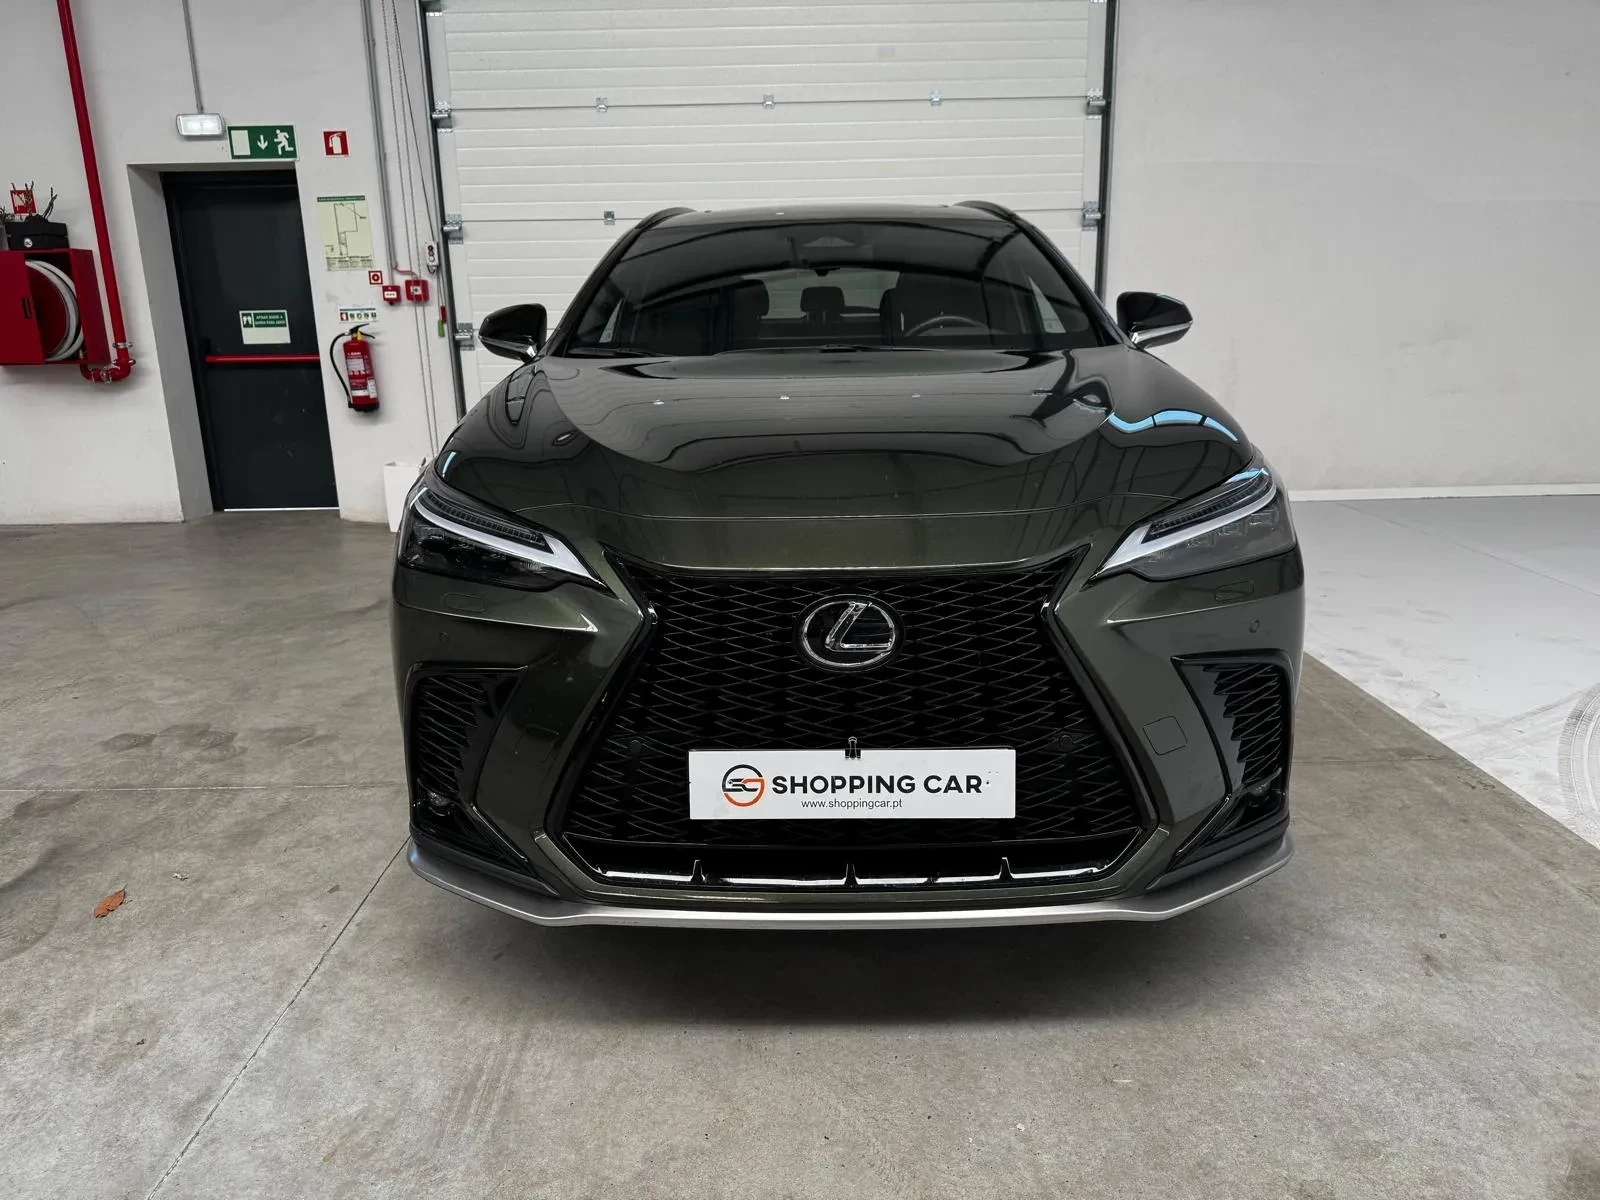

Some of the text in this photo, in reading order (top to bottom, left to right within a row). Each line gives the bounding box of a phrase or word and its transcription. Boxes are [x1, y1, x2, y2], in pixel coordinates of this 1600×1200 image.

[772, 775, 983, 794] SHOPPING CAR
[801, 798, 902, 810] www.shoppingcar.pt
